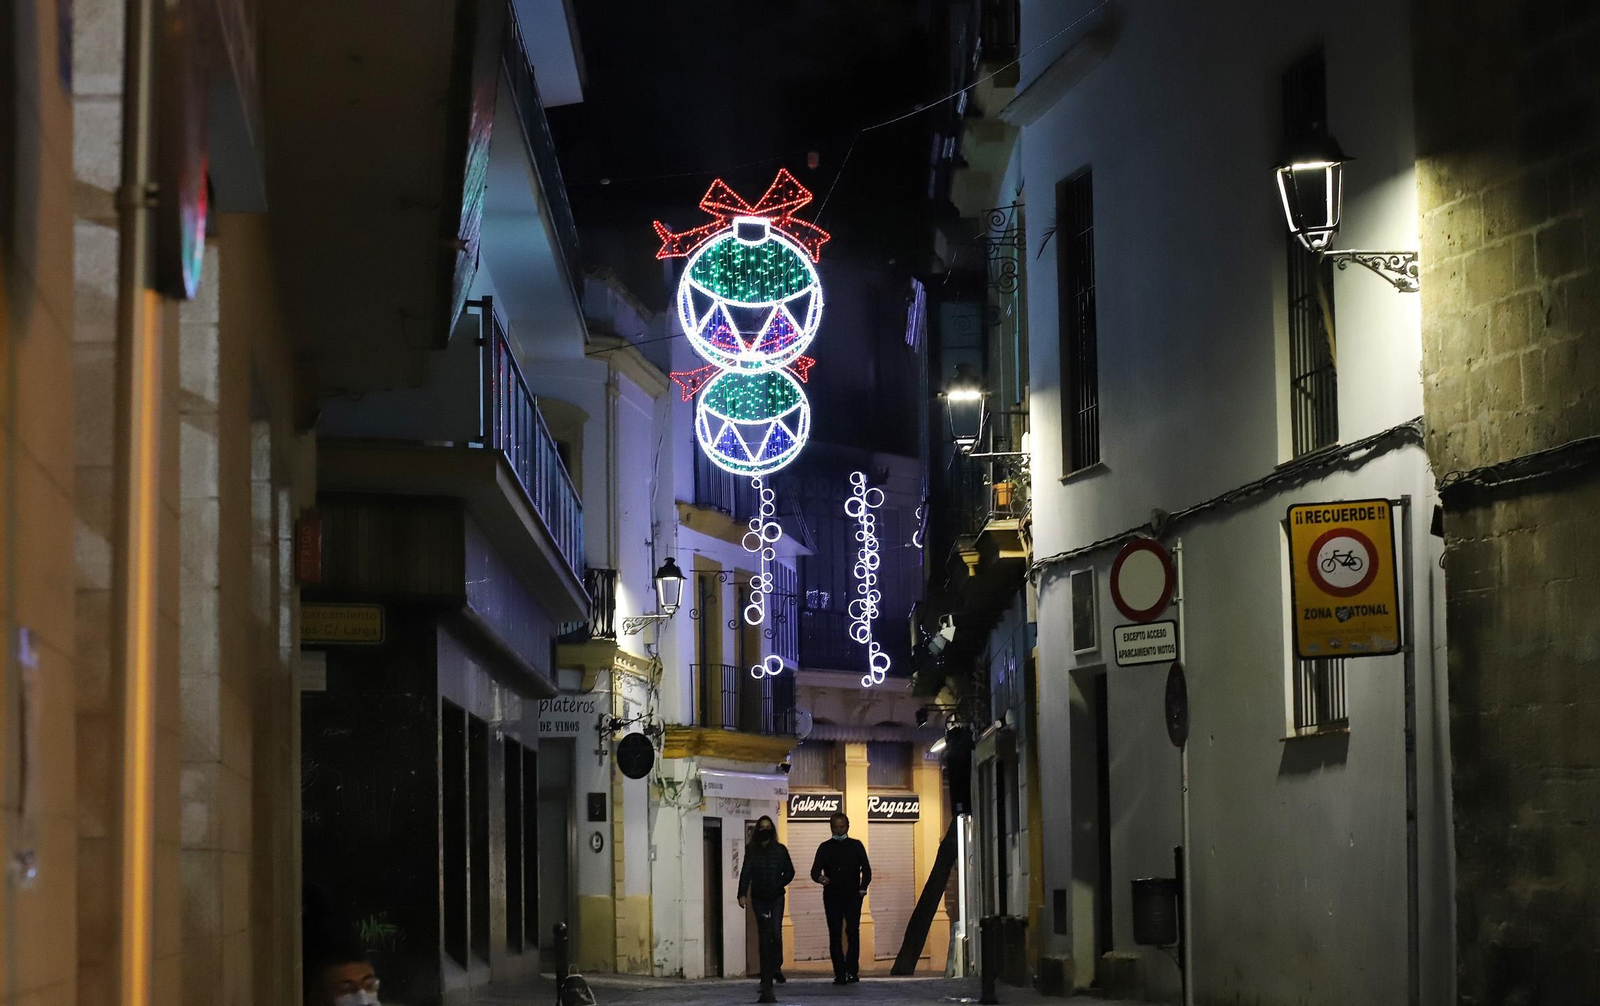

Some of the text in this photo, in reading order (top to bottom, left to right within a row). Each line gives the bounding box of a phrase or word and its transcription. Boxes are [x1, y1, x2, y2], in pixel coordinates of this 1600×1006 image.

[301, 610, 377, 620] parcamiento
[1304, 607, 1332, 620] ZONA
[1123, 628, 1167, 642] EXCEPTO ACCESO
[1118, 643, 1175, 659] APARCAMIENTO MOTOS
[540, 721, 580, 732] DE VINOS
[867, 796, 920, 818] Ragaza
